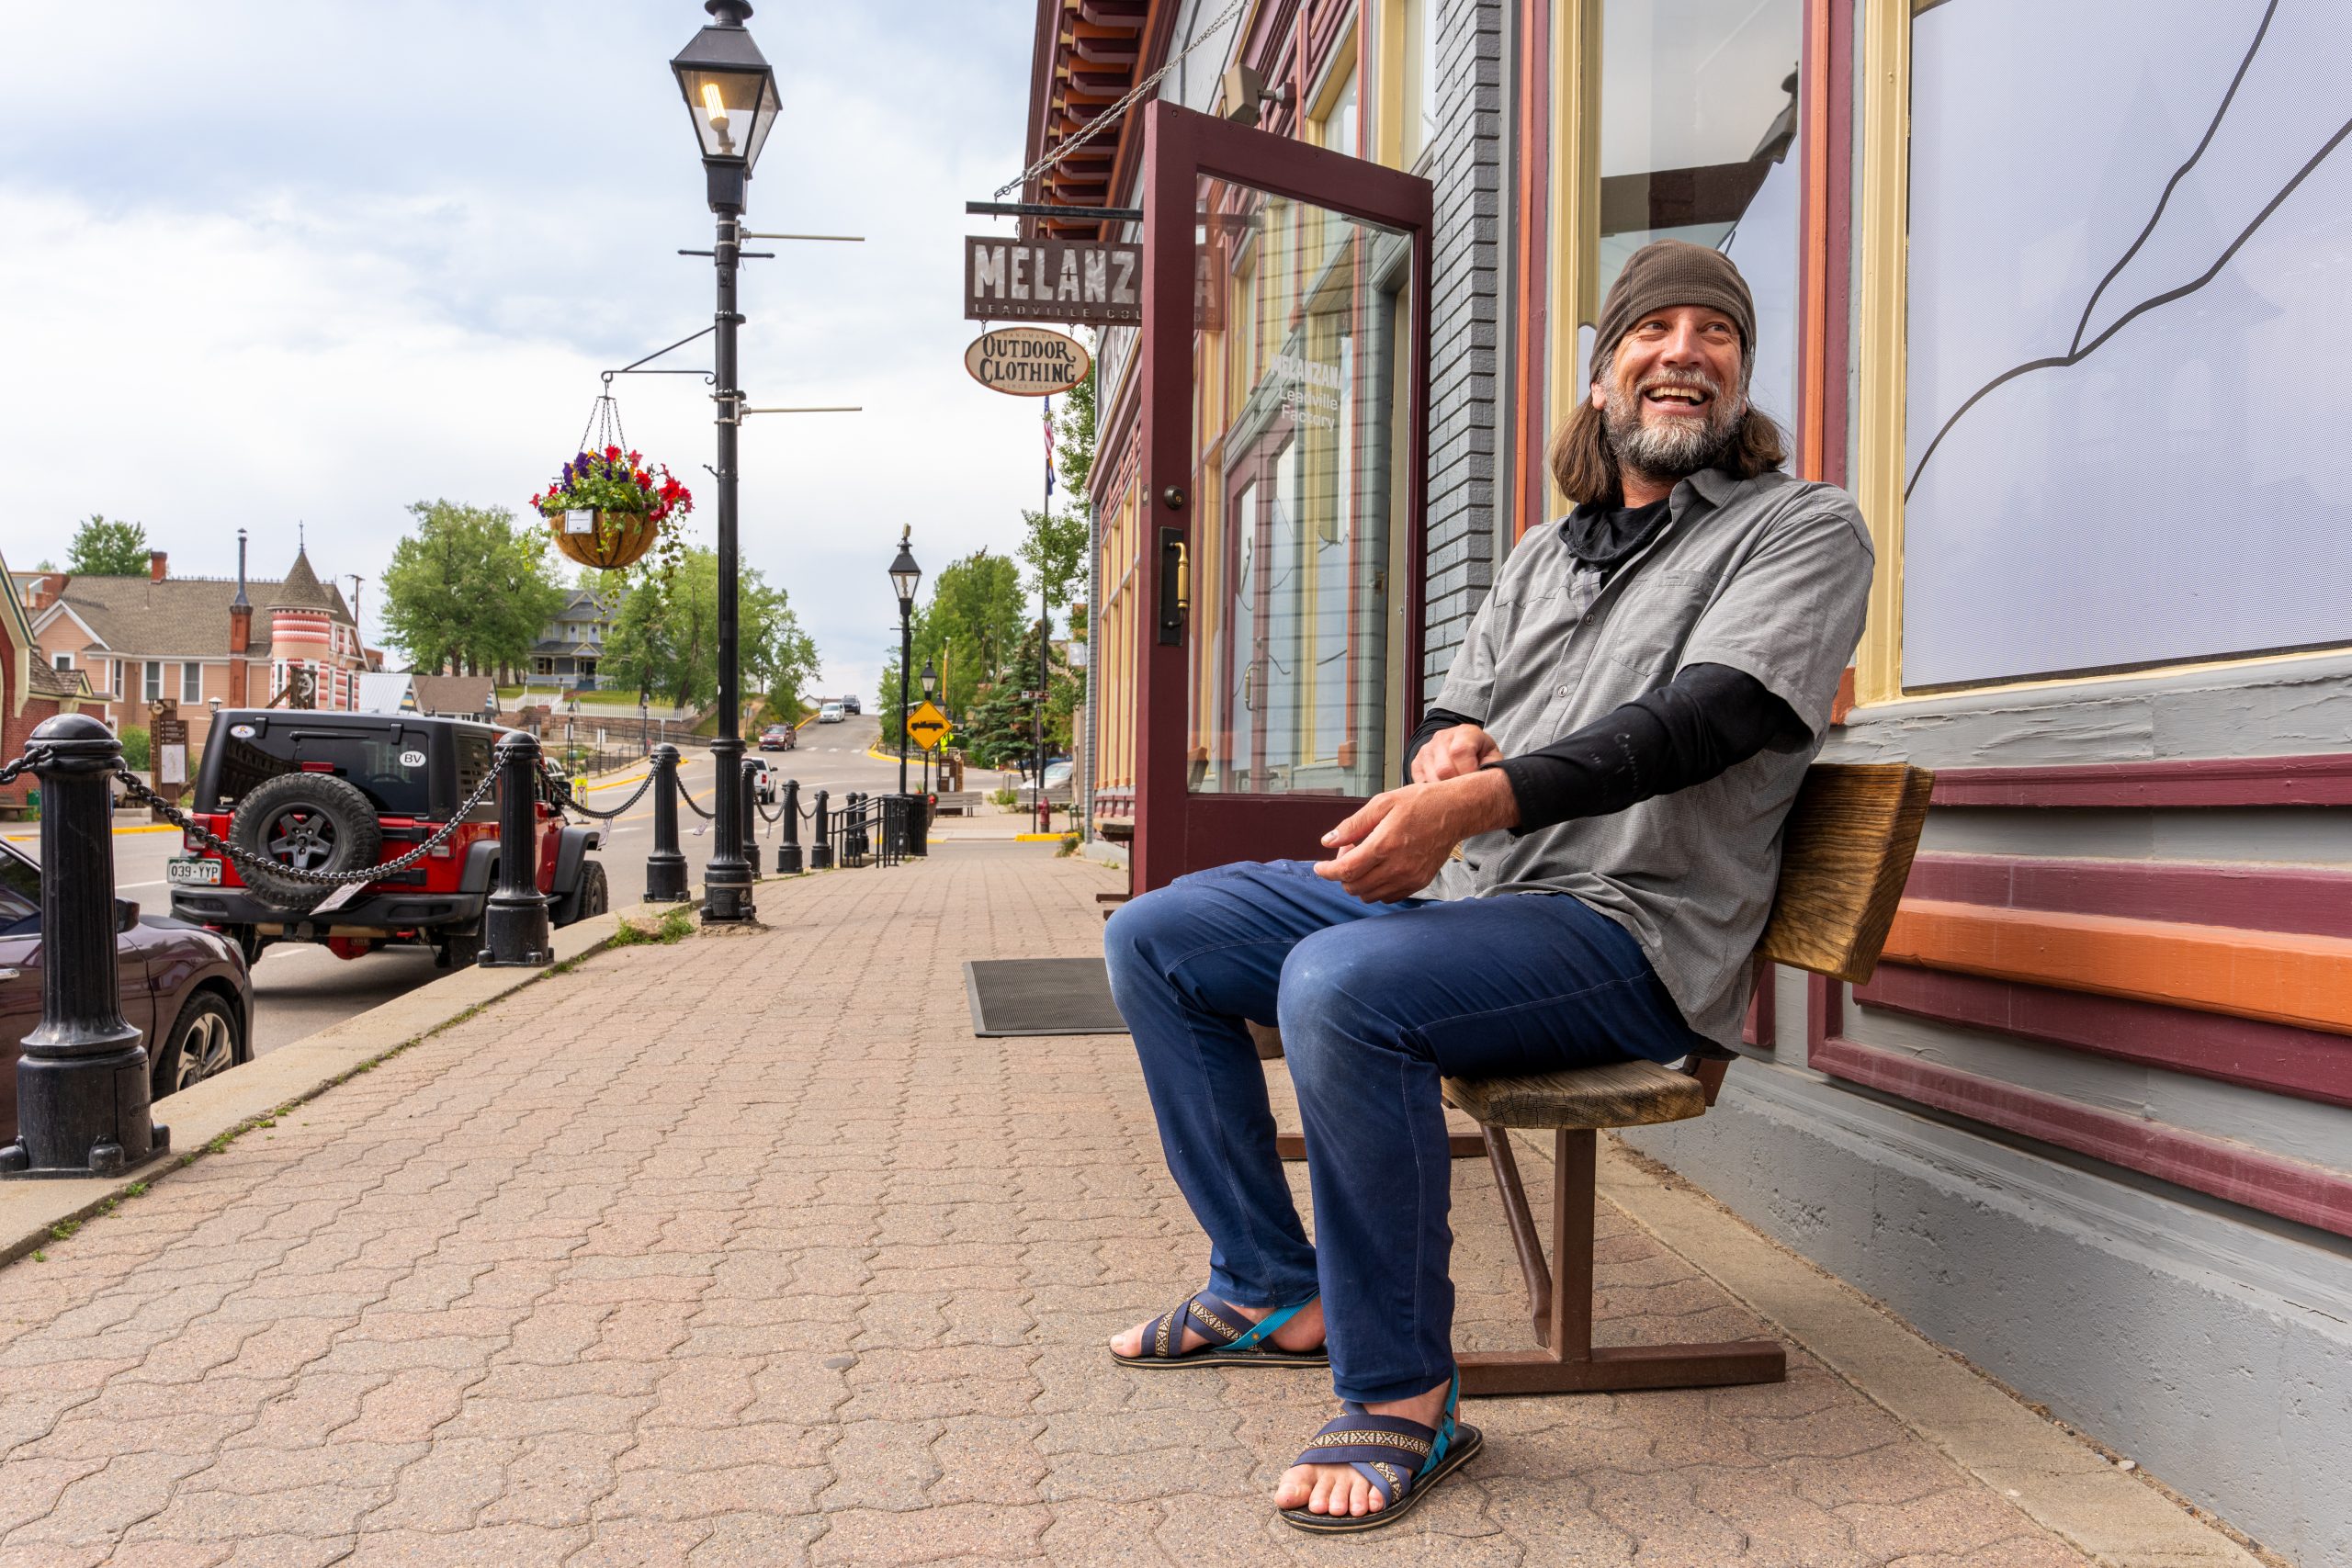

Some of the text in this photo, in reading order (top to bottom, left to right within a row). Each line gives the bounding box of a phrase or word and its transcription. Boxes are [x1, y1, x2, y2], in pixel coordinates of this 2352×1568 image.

[975, 303, 1091, 318] LEADVILLE
[982, 334, 1077, 363] OUTDOOR
[979, 357, 1077, 385] CLOTHING
[1279, 384, 1338, 411] Leadville
[1282, 403, 1335, 432] Factory
[404, 753, 422, 763] BV
